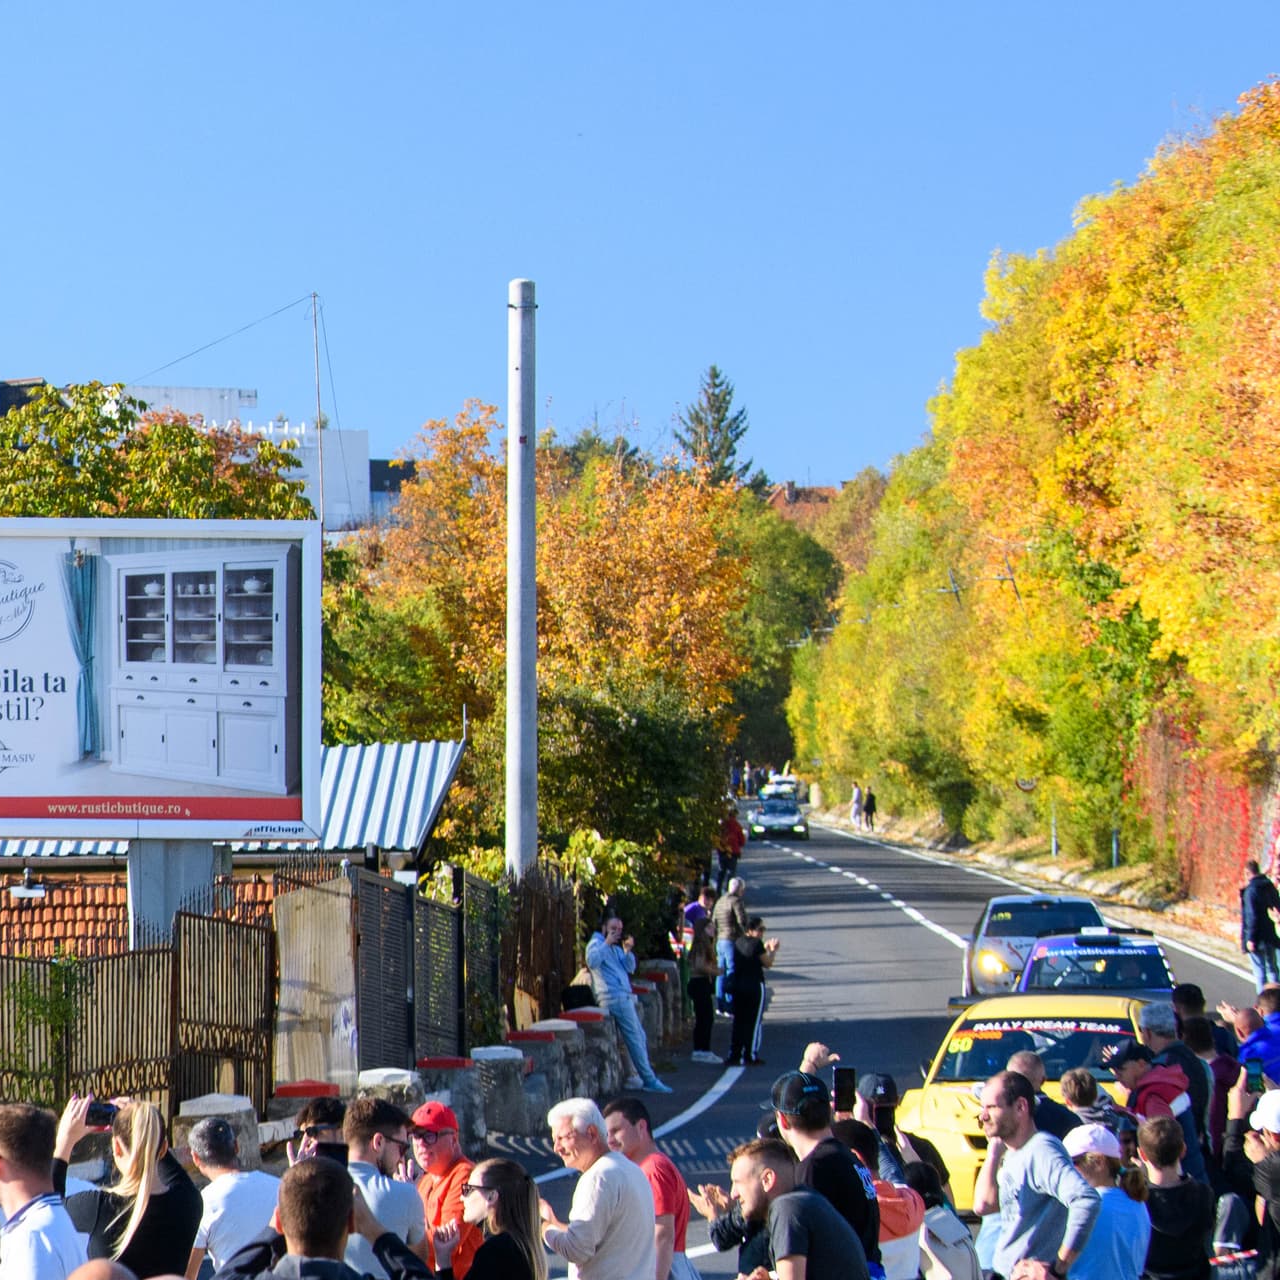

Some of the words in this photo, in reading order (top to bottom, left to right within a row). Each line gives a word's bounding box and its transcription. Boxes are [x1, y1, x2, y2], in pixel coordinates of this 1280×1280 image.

[43, 672, 67, 694] ta
[1, 753, 36, 763] MASIV
[47, 801, 181, 817] www.rusticbutique.ro
[253, 825, 305, 835] affichage
[972, 1020, 1022, 1032] RALLY
[1022, 1020, 1077, 1031] DREAM
[1079, 1021, 1121, 1033] TEAM
